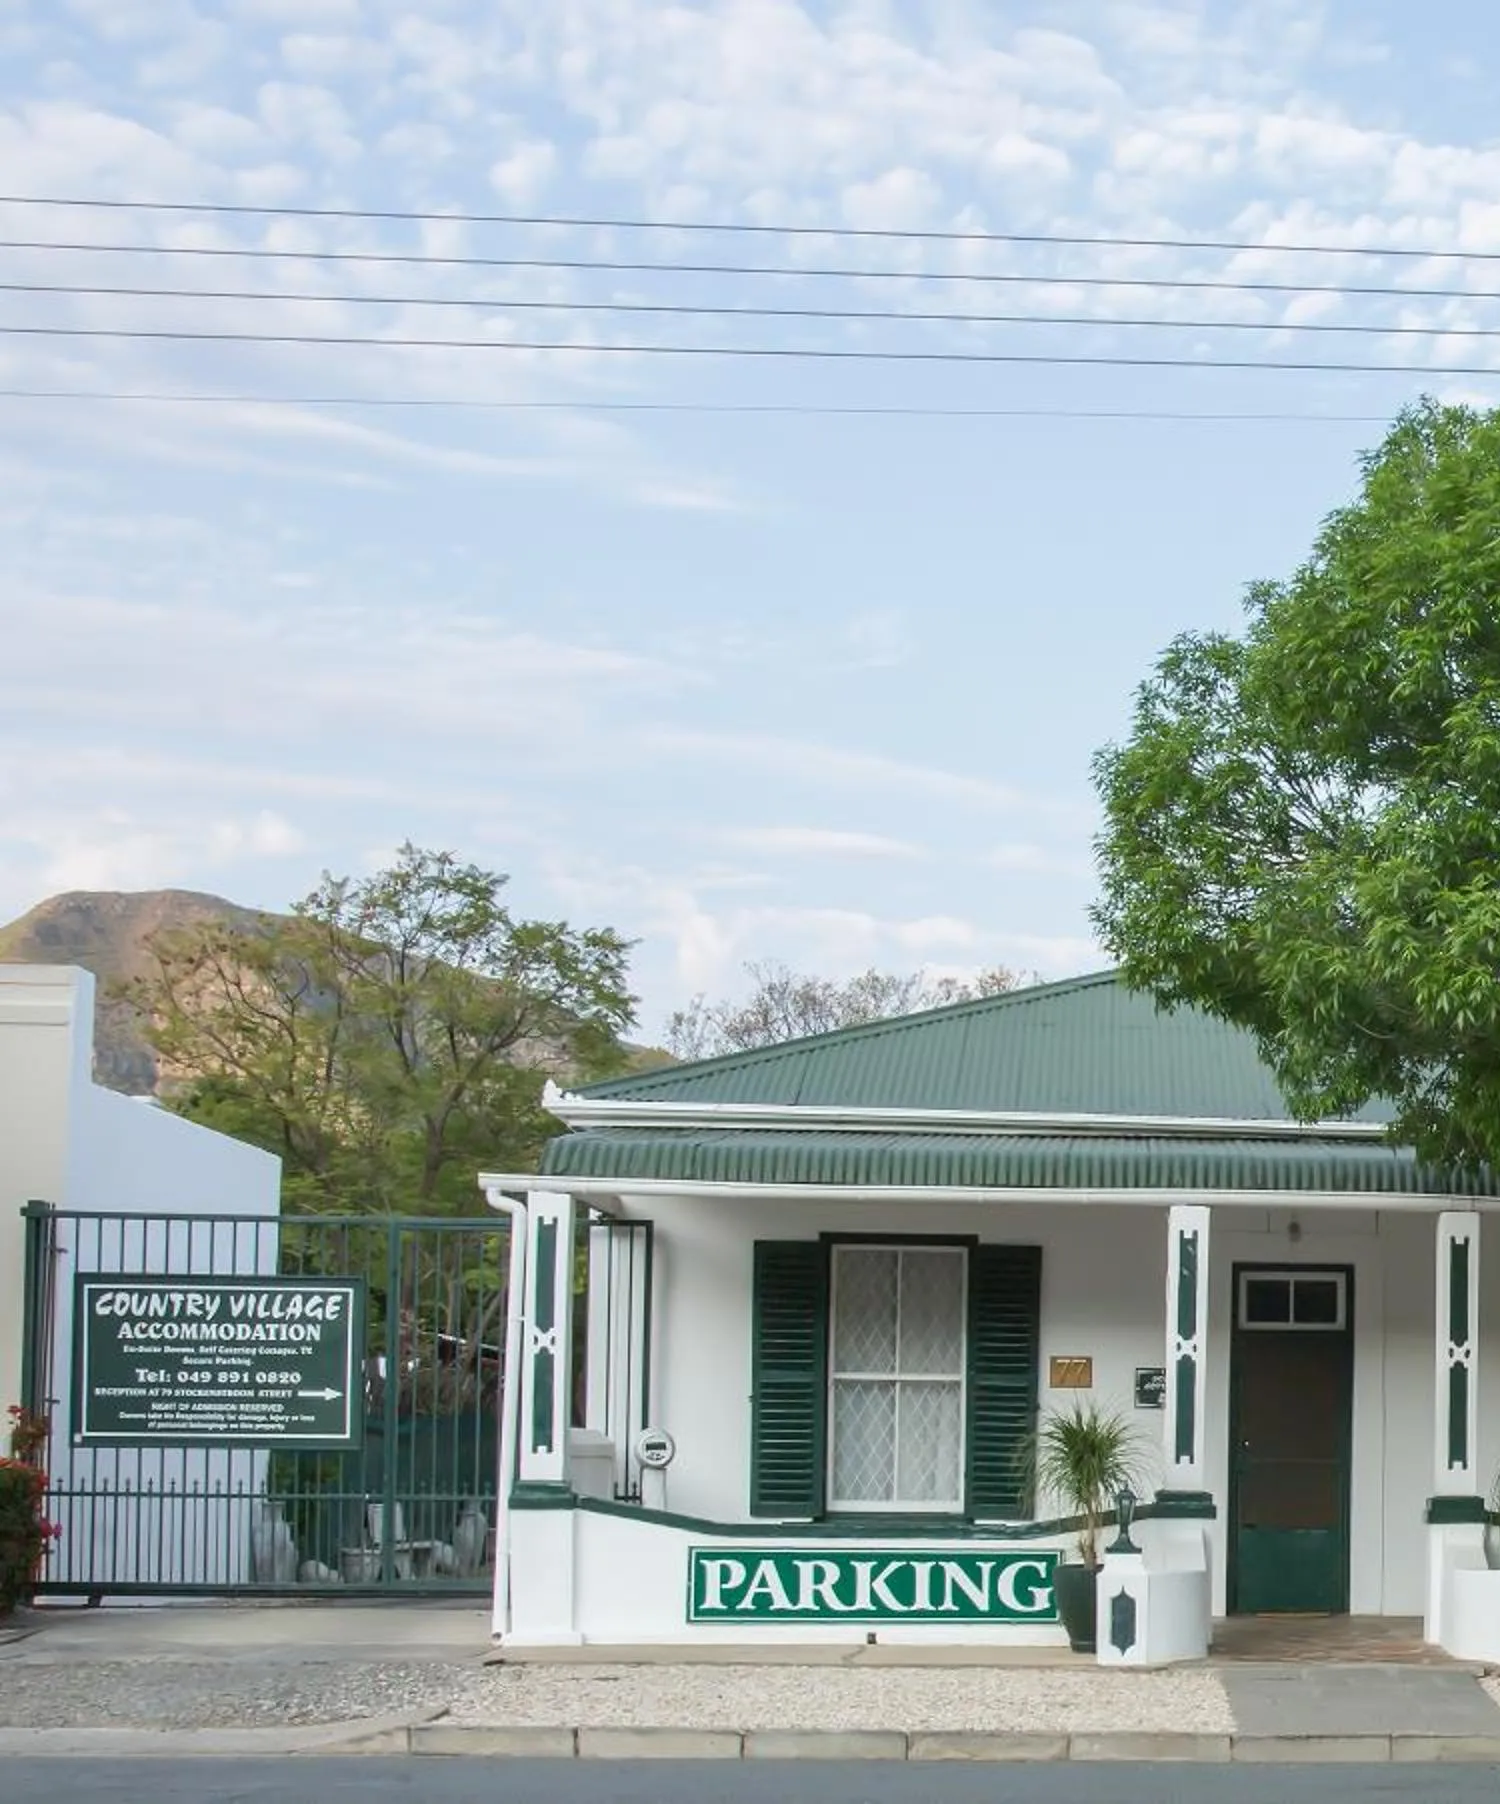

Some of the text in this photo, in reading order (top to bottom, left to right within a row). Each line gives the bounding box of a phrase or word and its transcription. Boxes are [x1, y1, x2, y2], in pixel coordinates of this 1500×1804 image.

[95, 1291, 343, 1321] COUNTRY VILLAGE
[117, 1321, 322, 1341] ACCOMMODATION
[135, 1368, 302, 1385] Tel: 049 891 0820
[1056, 1359, 1087, 1384] 77
[148, 1387, 160, 1397] AT
[699, 1558, 1054, 1612] PARKING
